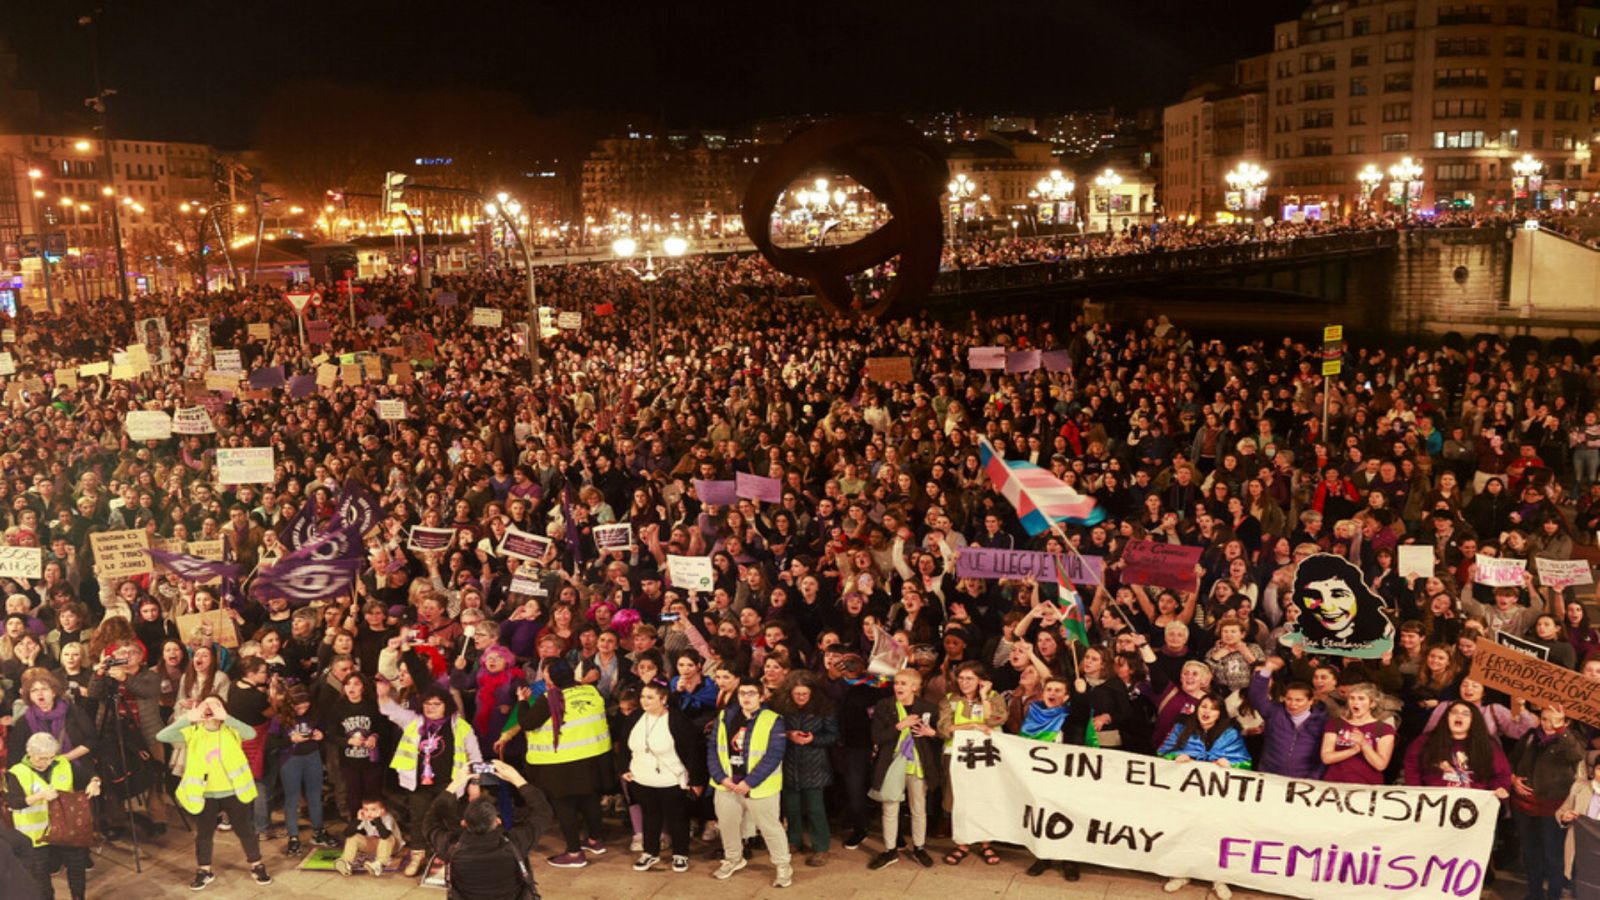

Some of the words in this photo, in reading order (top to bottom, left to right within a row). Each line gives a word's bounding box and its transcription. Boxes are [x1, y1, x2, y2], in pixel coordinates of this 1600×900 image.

[1028, 746, 1103, 781] SIN
[1125, 759, 1171, 790] EL
[1284, 780, 1480, 830] RACISMO
[1022, 804, 1074, 840] NO
[1086, 818, 1165, 853] HAY
